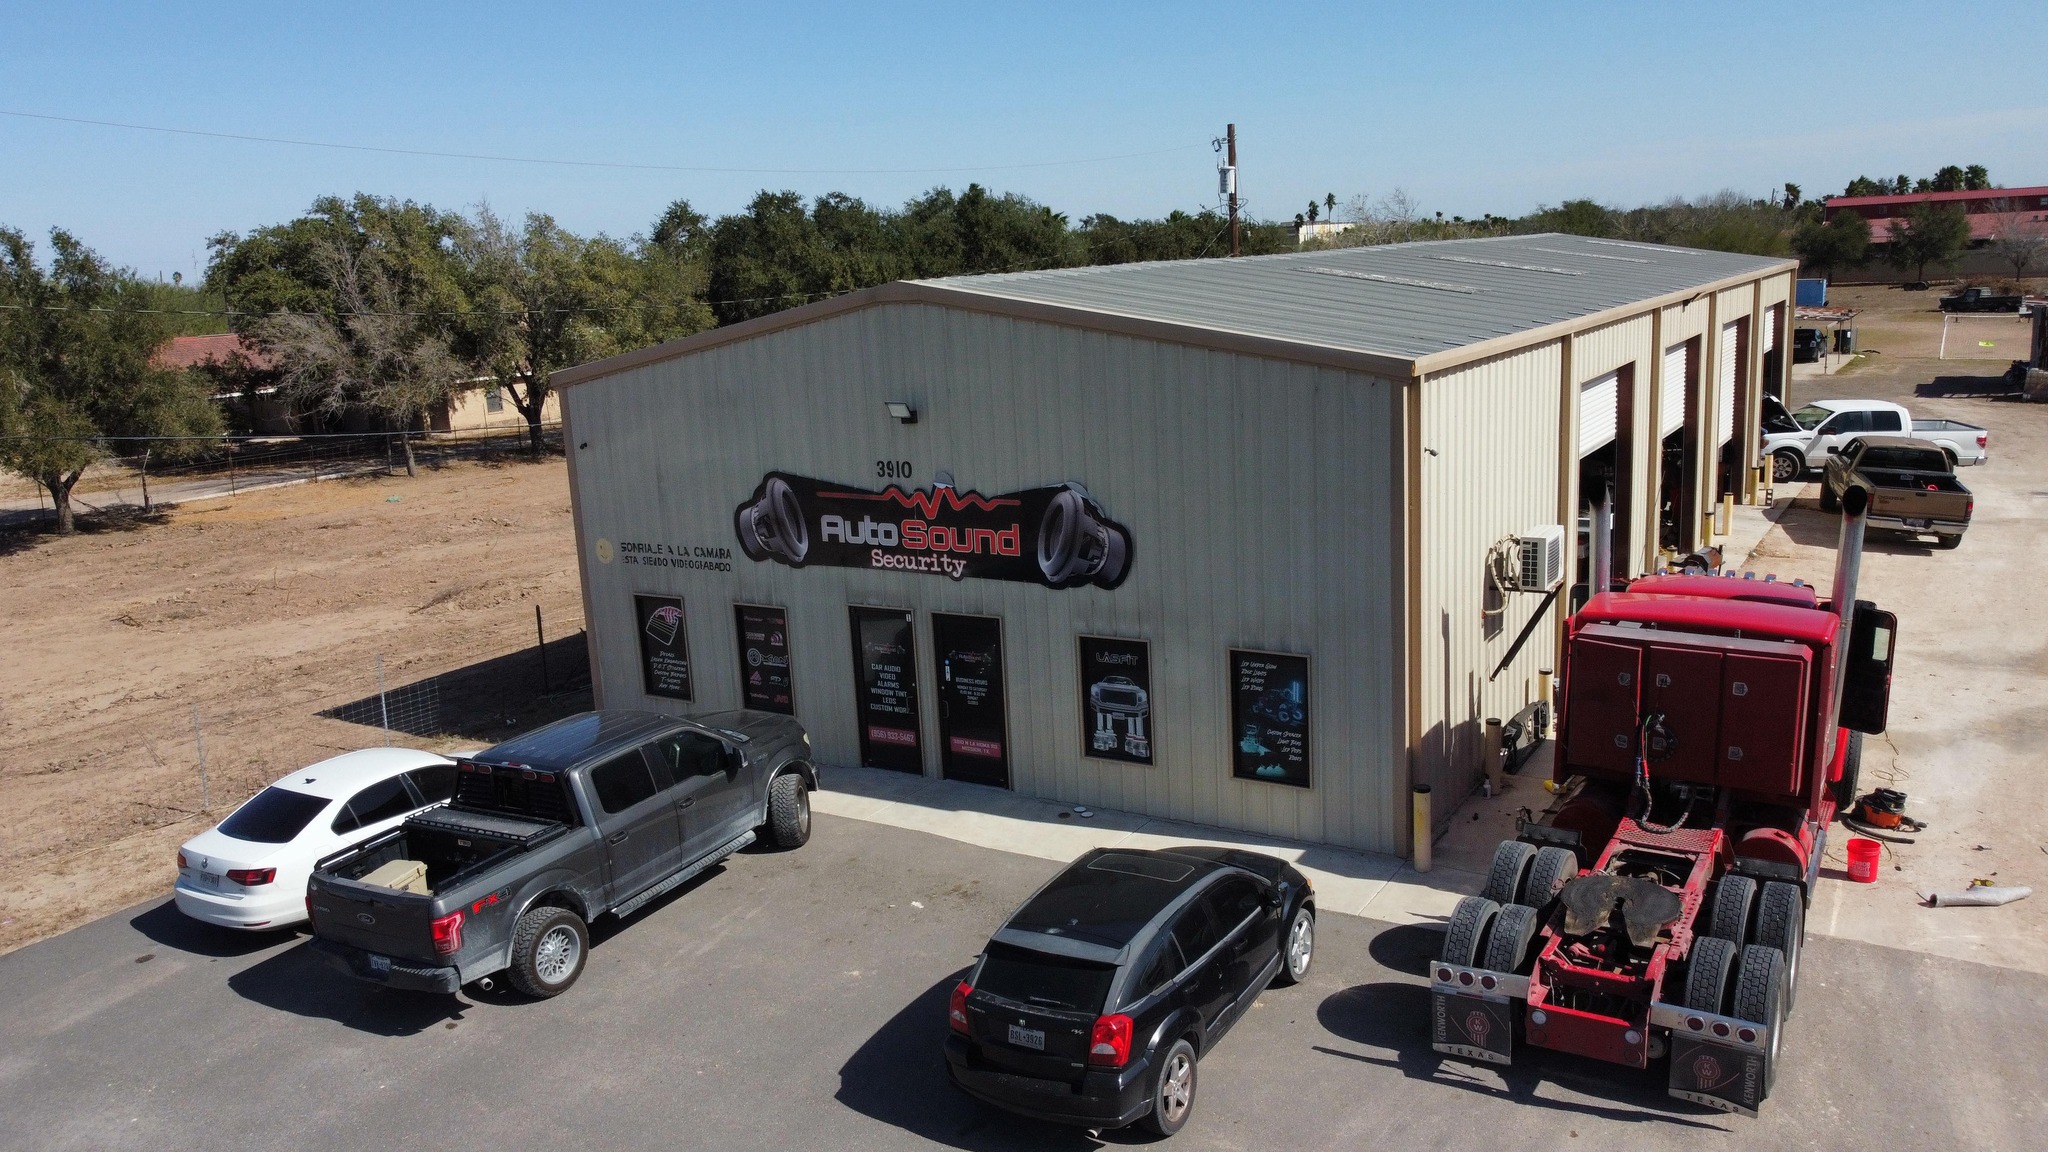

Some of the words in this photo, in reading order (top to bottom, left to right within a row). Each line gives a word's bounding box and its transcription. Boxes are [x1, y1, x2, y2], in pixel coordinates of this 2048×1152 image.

[876, 460, 912, 478] 3910
[668, 544, 674, 555] A
[677, 546, 690, 556] LA
[622, 556, 638, 564] STA
[871, 550, 967, 577] Security
[871, 688, 894, 696] WINDOW
[870, 703, 893, 712] CUSTOM
[472, 886, 511, 914] FX4
[1437, 995, 1446, 1042] KENWORTH
[1448, 1046, 1494, 1060] TEXAS
[1743, 1055, 1757, 1105] KENWORTH
[1686, 1093, 1739, 1112] TEXAS
